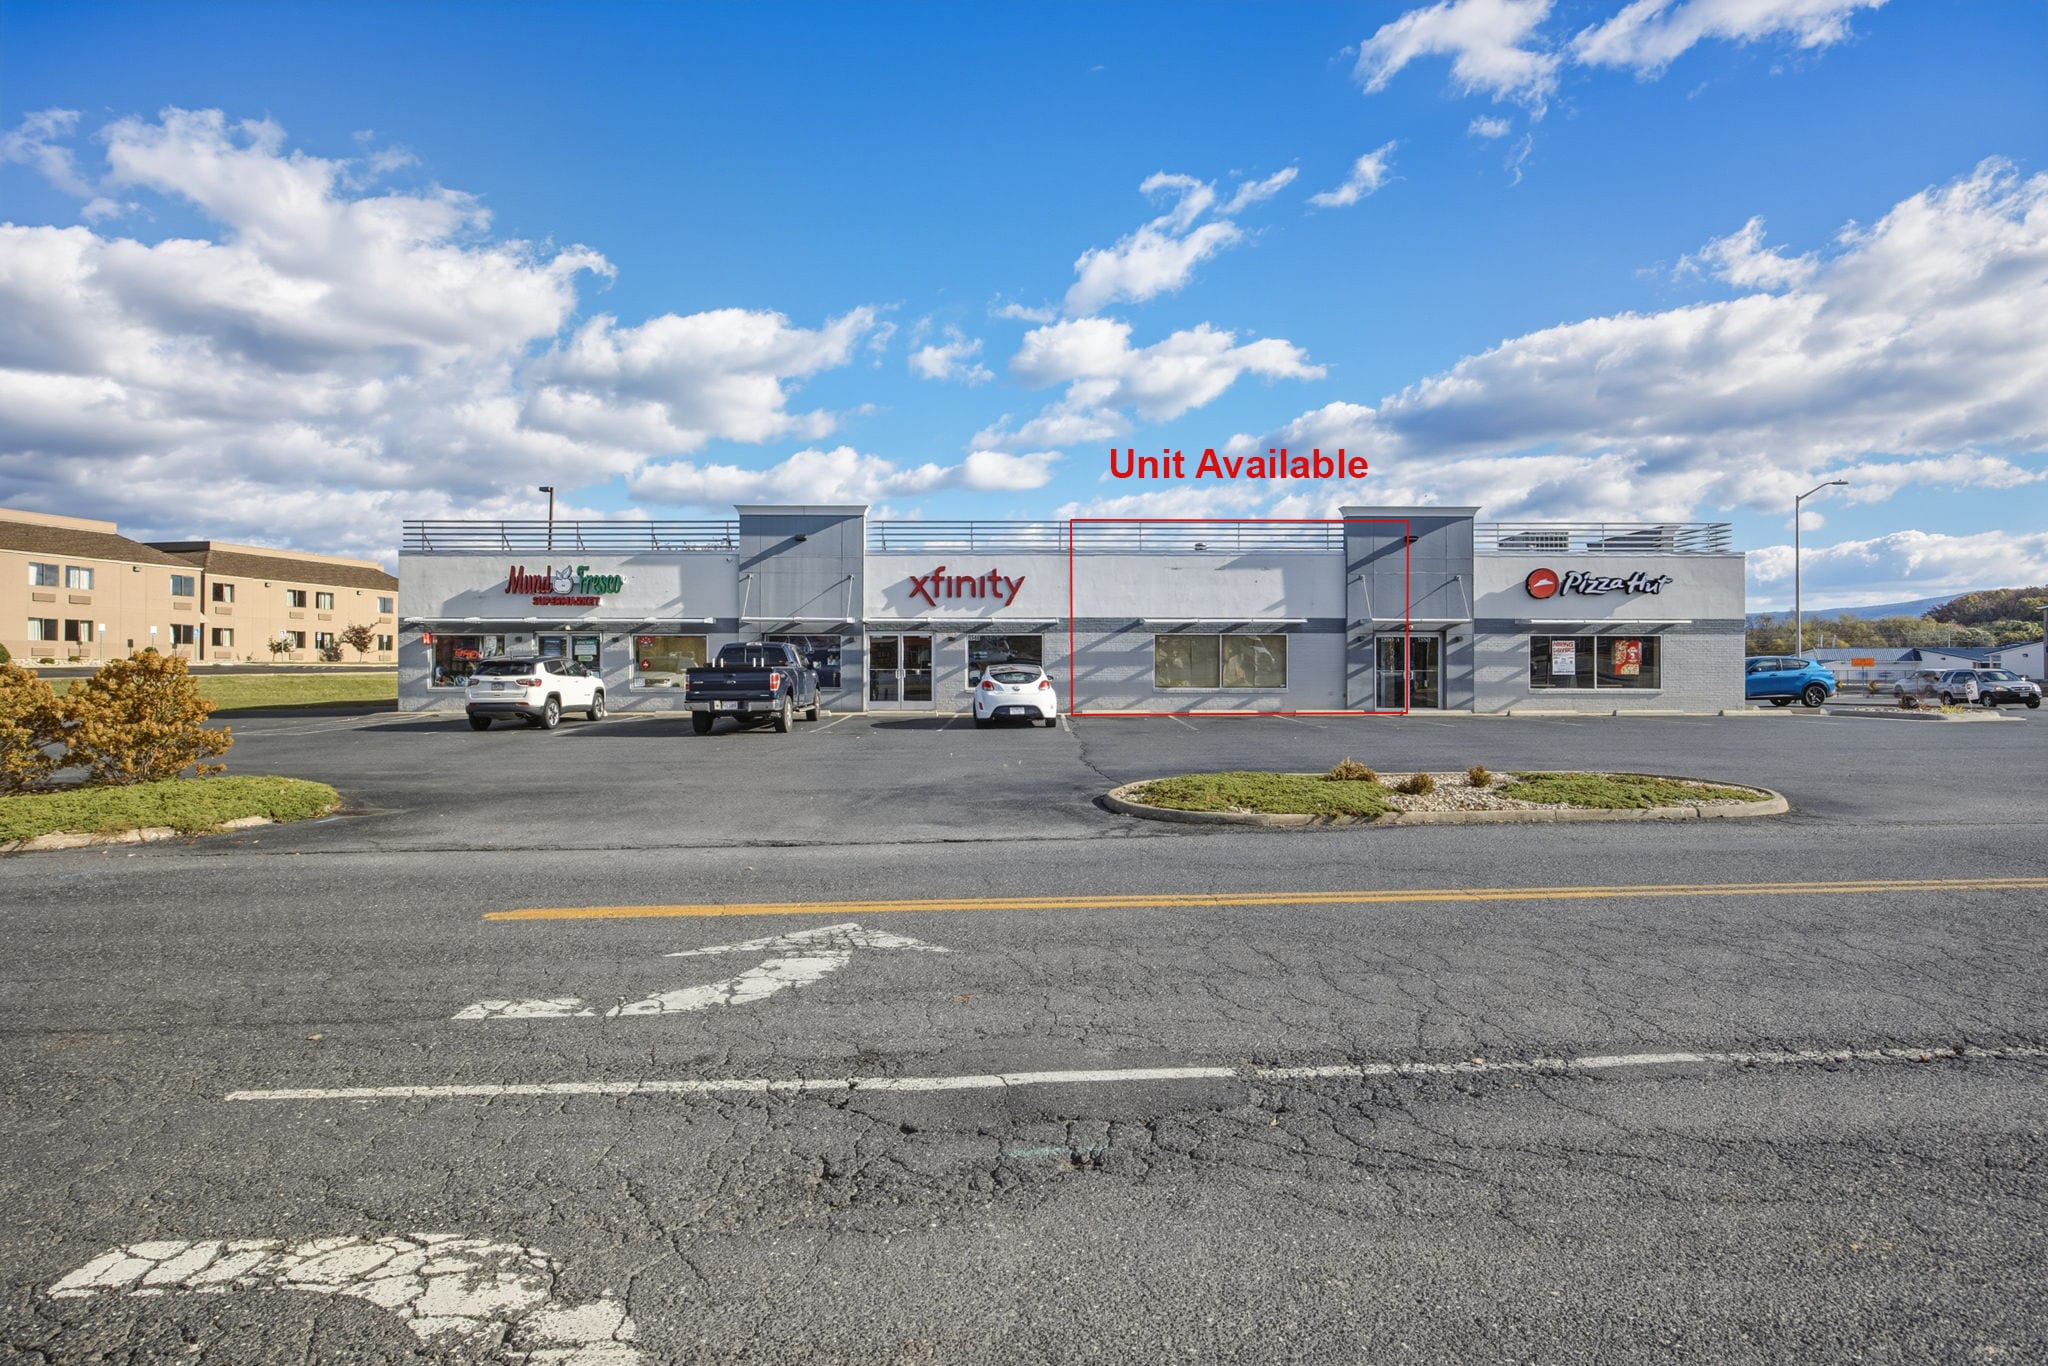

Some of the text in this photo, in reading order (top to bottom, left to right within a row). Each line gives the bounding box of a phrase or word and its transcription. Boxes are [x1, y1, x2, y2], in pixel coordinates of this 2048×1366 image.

[576, 565, 623, 594] Fresco
[908, 565, 1026, 607] xfinity
[1560, 570, 1673, 596] Pizza Hut
[532, 596, 601, 606] SUPERMARKET
